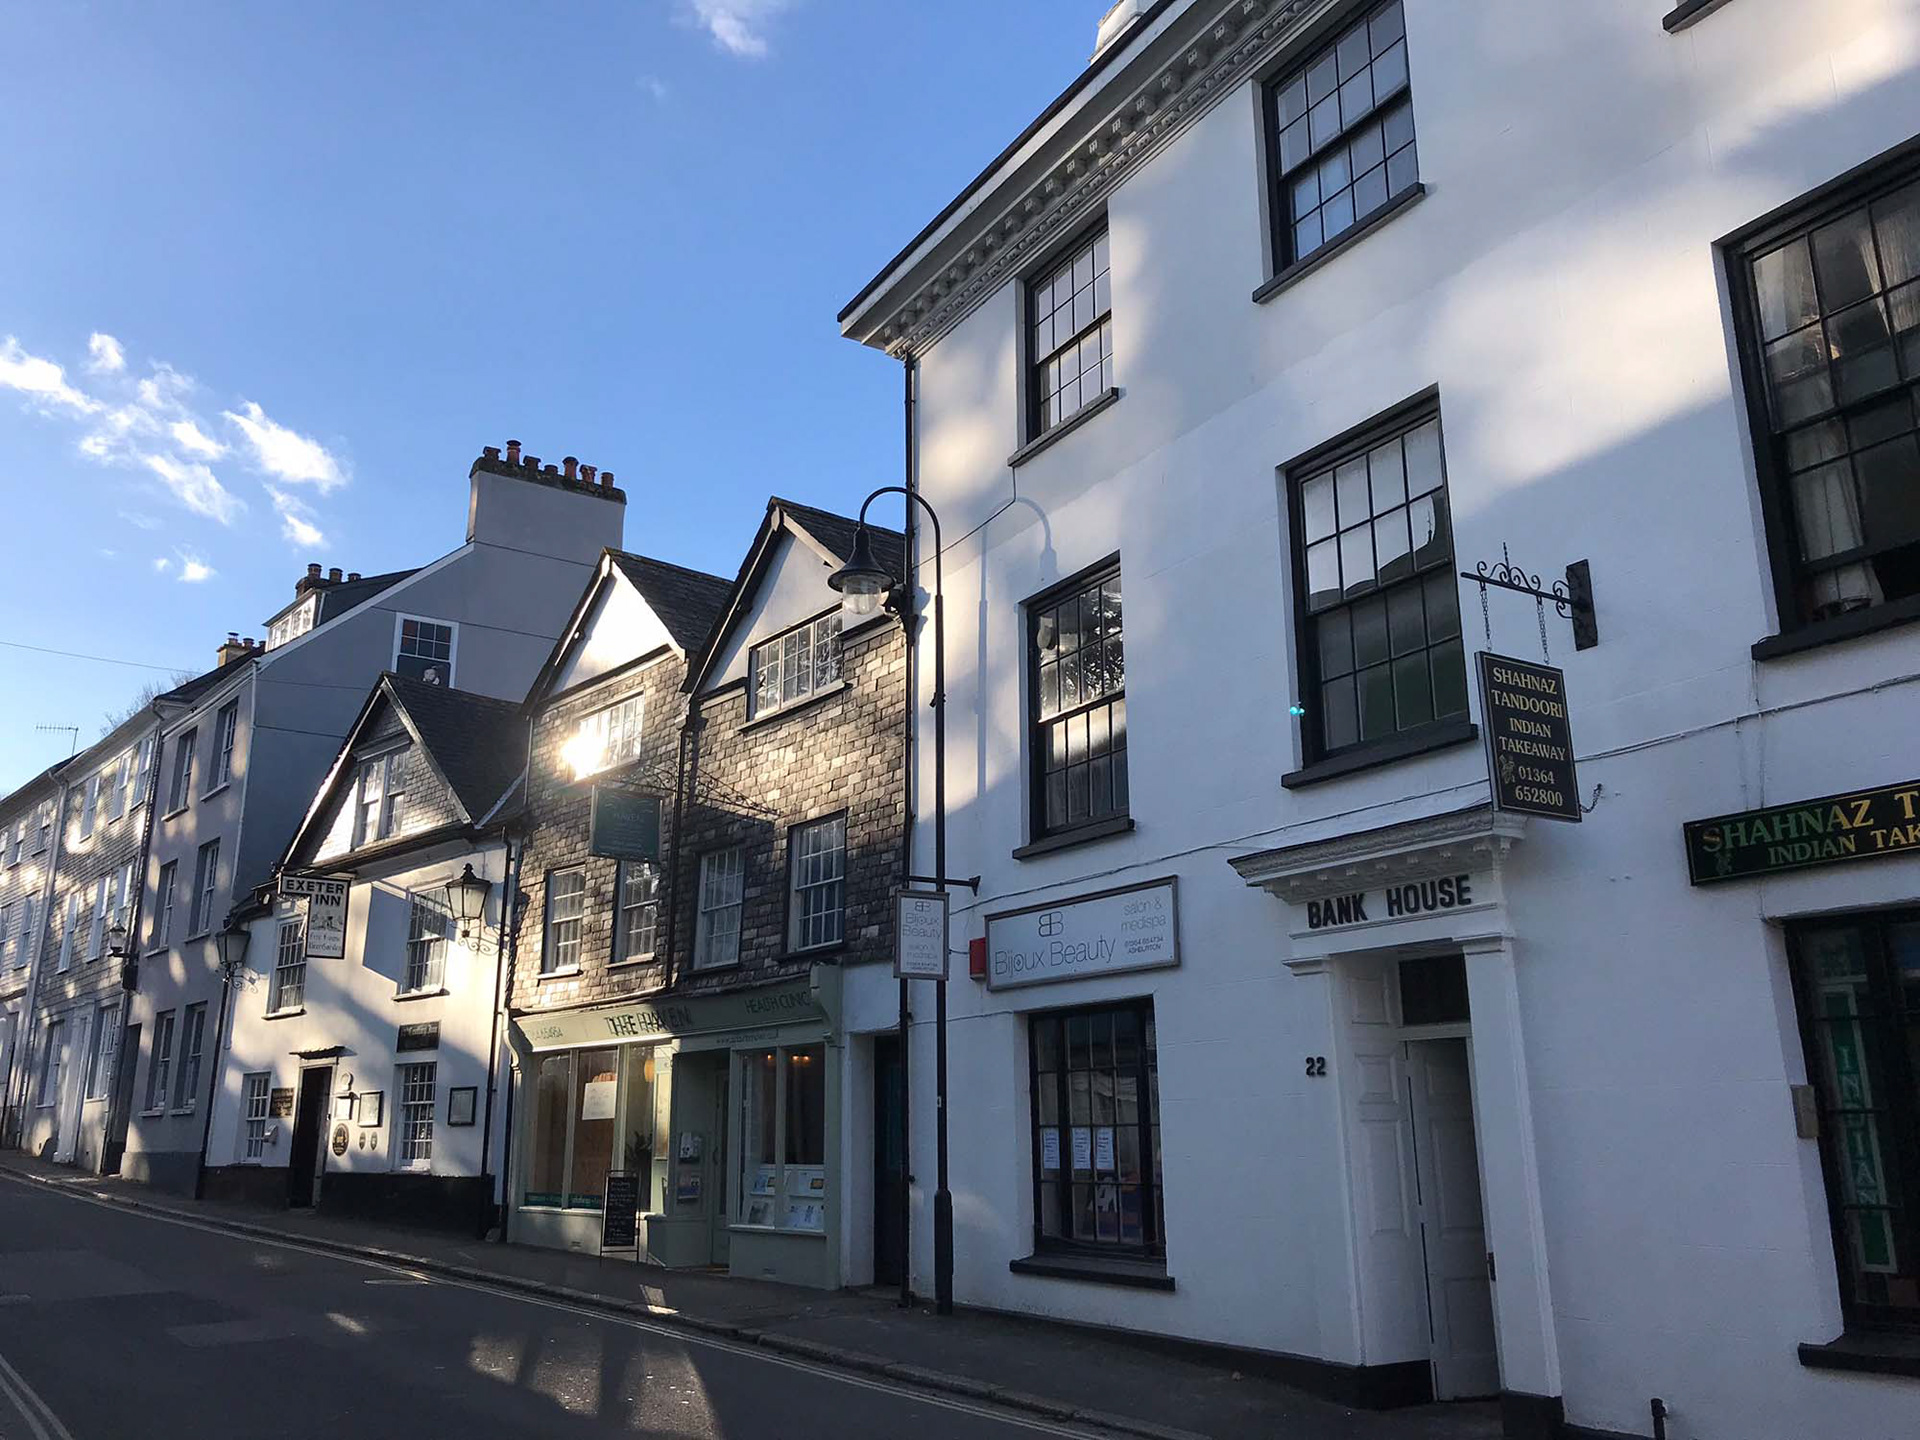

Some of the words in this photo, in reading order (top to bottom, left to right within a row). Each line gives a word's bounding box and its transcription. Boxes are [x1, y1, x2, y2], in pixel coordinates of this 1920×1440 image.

[1492, 666, 1558, 695] SHAHNAZ
[1491, 689, 1563, 719] TANDOORI
[1509, 717, 1552, 738] INDIAN
[1498, 736, 1566, 761] TAKEAWAY
[1518, 765, 1555, 785] 01364
[1515, 785, 1563, 807] 652800
[1701, 799, 1874, 853] SHAHNAZ
[1768, 834, 1856, 865] INDIAN
[286, 879, 345, 895] EXETER
[315, 894, 341, 907] INN
[1307, 893, 1368, 929] BANK
[1386, 874, 1472, 917] HOUSE
[902, 924, 942, 940] Beauty
[995, 949, 1046, 978] Bijoux
[1050, 935, 1117, 967] Beauty
[1305, 1056, 1327, 1076] 22
